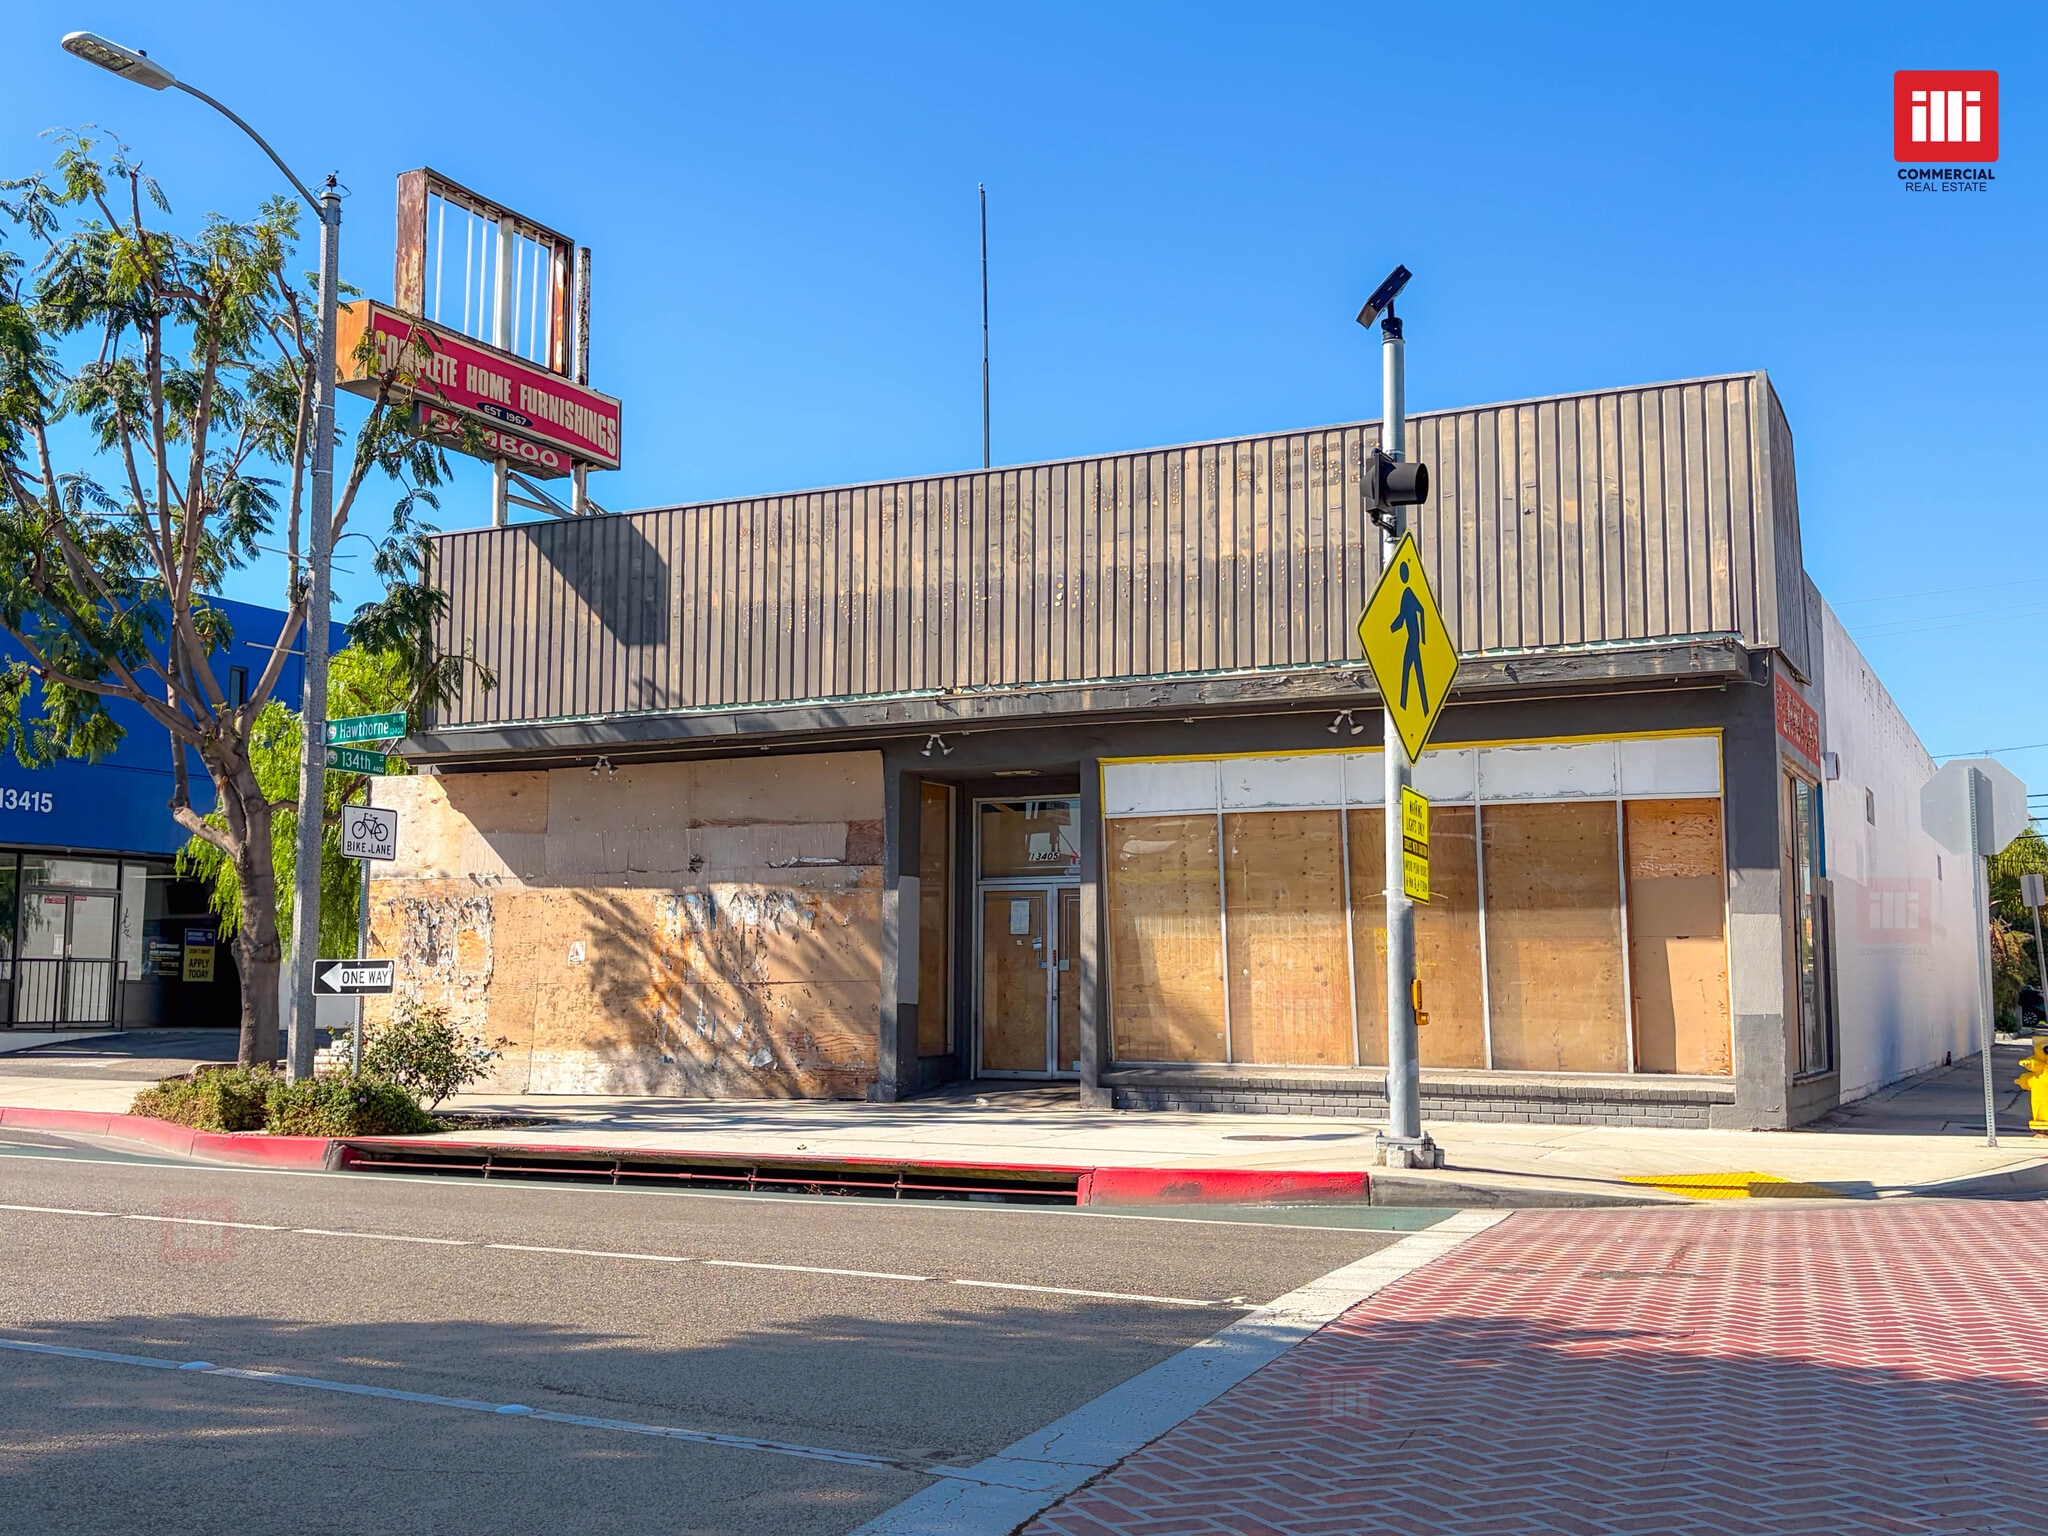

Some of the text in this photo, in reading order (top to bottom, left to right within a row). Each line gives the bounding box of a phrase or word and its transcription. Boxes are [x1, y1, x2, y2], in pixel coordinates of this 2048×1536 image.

[466, 363, 512, 406] HOME
[519, 383, 618, 458] FURNISHINGS
[484, 404, 527, 426] EST 1967
[339, 720, 389, 740] Hawthorne
[342, 751, 371, 771] 134th
[347, 840, 392, 856] BIKE LANE
[1030, 852, 1059, 861] 13405
[188, 958, 209, 969] APPLY
[188, 969, 209, 979] TODAY
[341, 970, 389, 984] ONE WAY
